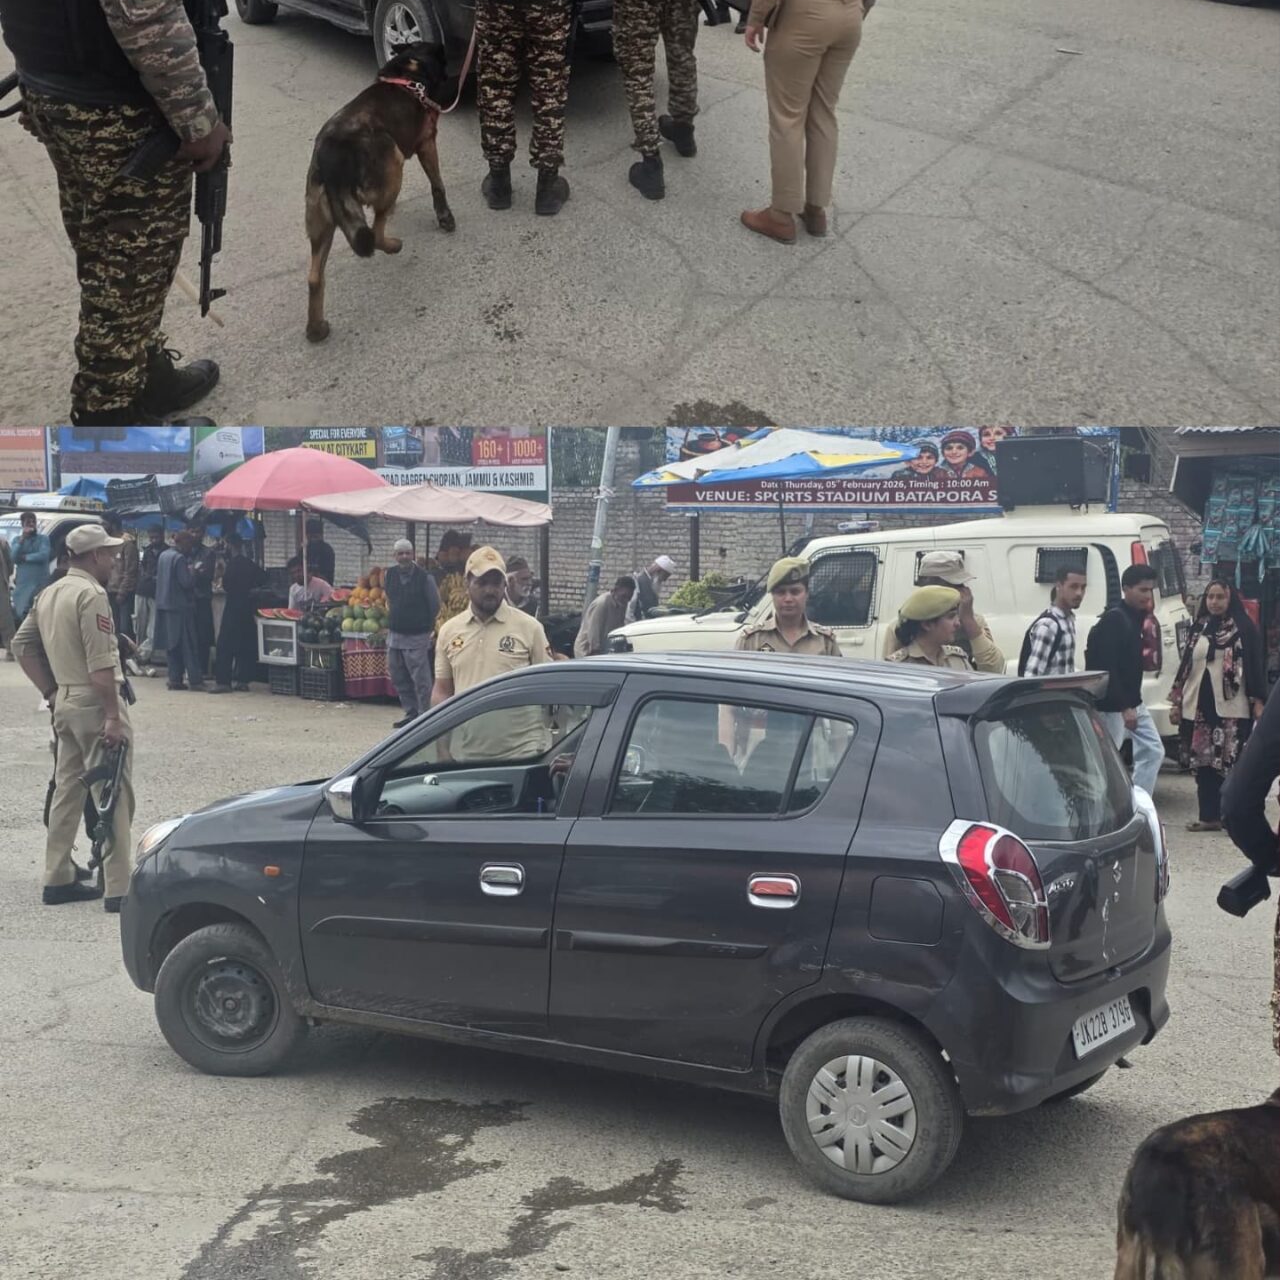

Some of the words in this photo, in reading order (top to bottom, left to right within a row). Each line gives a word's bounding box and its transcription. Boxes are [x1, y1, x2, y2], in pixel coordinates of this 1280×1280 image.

[310, 429, 329, 439] SPECIAL
[330, 429, 340, 438] FOR
[341, 428, 367, 438] EVERYONE
[327, 444, 335, 454] AT
[336, 443, 367, 456] CITYKART
[478, 440, 503, 458] 160+
[513, 439, 543, 457] 1000+
[465, 474, 490, 487] JAMMU
[493, 472, 498, 486] &
[500, 472, 534, 486] KASHMIR
[785, 481, 823, 489] Thursday,
[843, 481, 881, 489] February
[883, 481, 907, 489] 2026,
[909, 480, 939, 489] Timing
[695, 491, 751, 501] VENUE:
[754, 491, 813, 502] SPORTS
[816, 491, 890, 503] STADIUM
[895, 491, 983, 502] BATAPORA
[1080, 1011, 1109, 1046] JK22B
